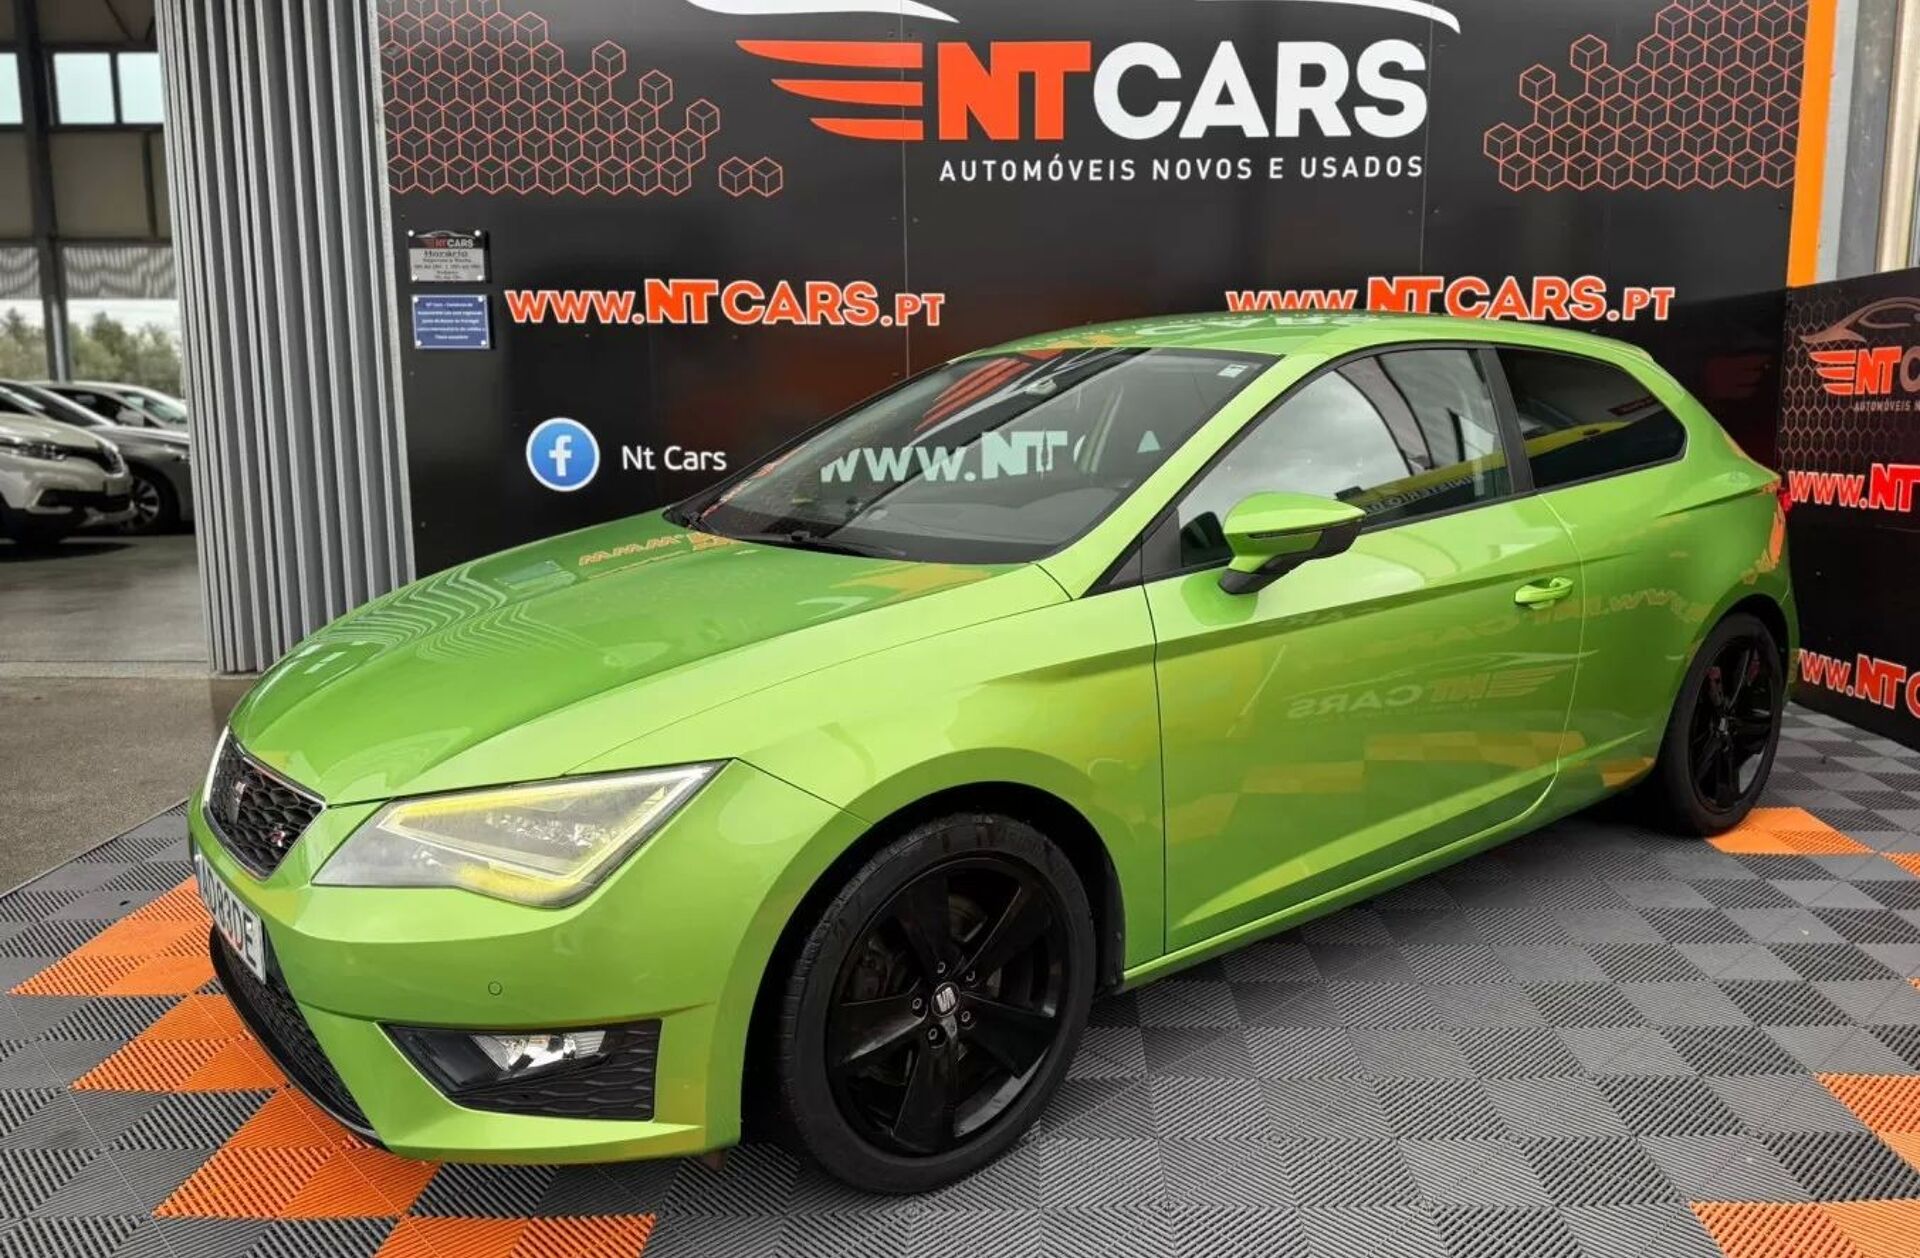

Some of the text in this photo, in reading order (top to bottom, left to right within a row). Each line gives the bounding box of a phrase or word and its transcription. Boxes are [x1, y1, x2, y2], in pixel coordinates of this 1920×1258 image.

[939, 153, 1423, 182] AUTOMÓVEIS NOVOS E USADOS
[622, 446, 727, 471] Nt Cars
